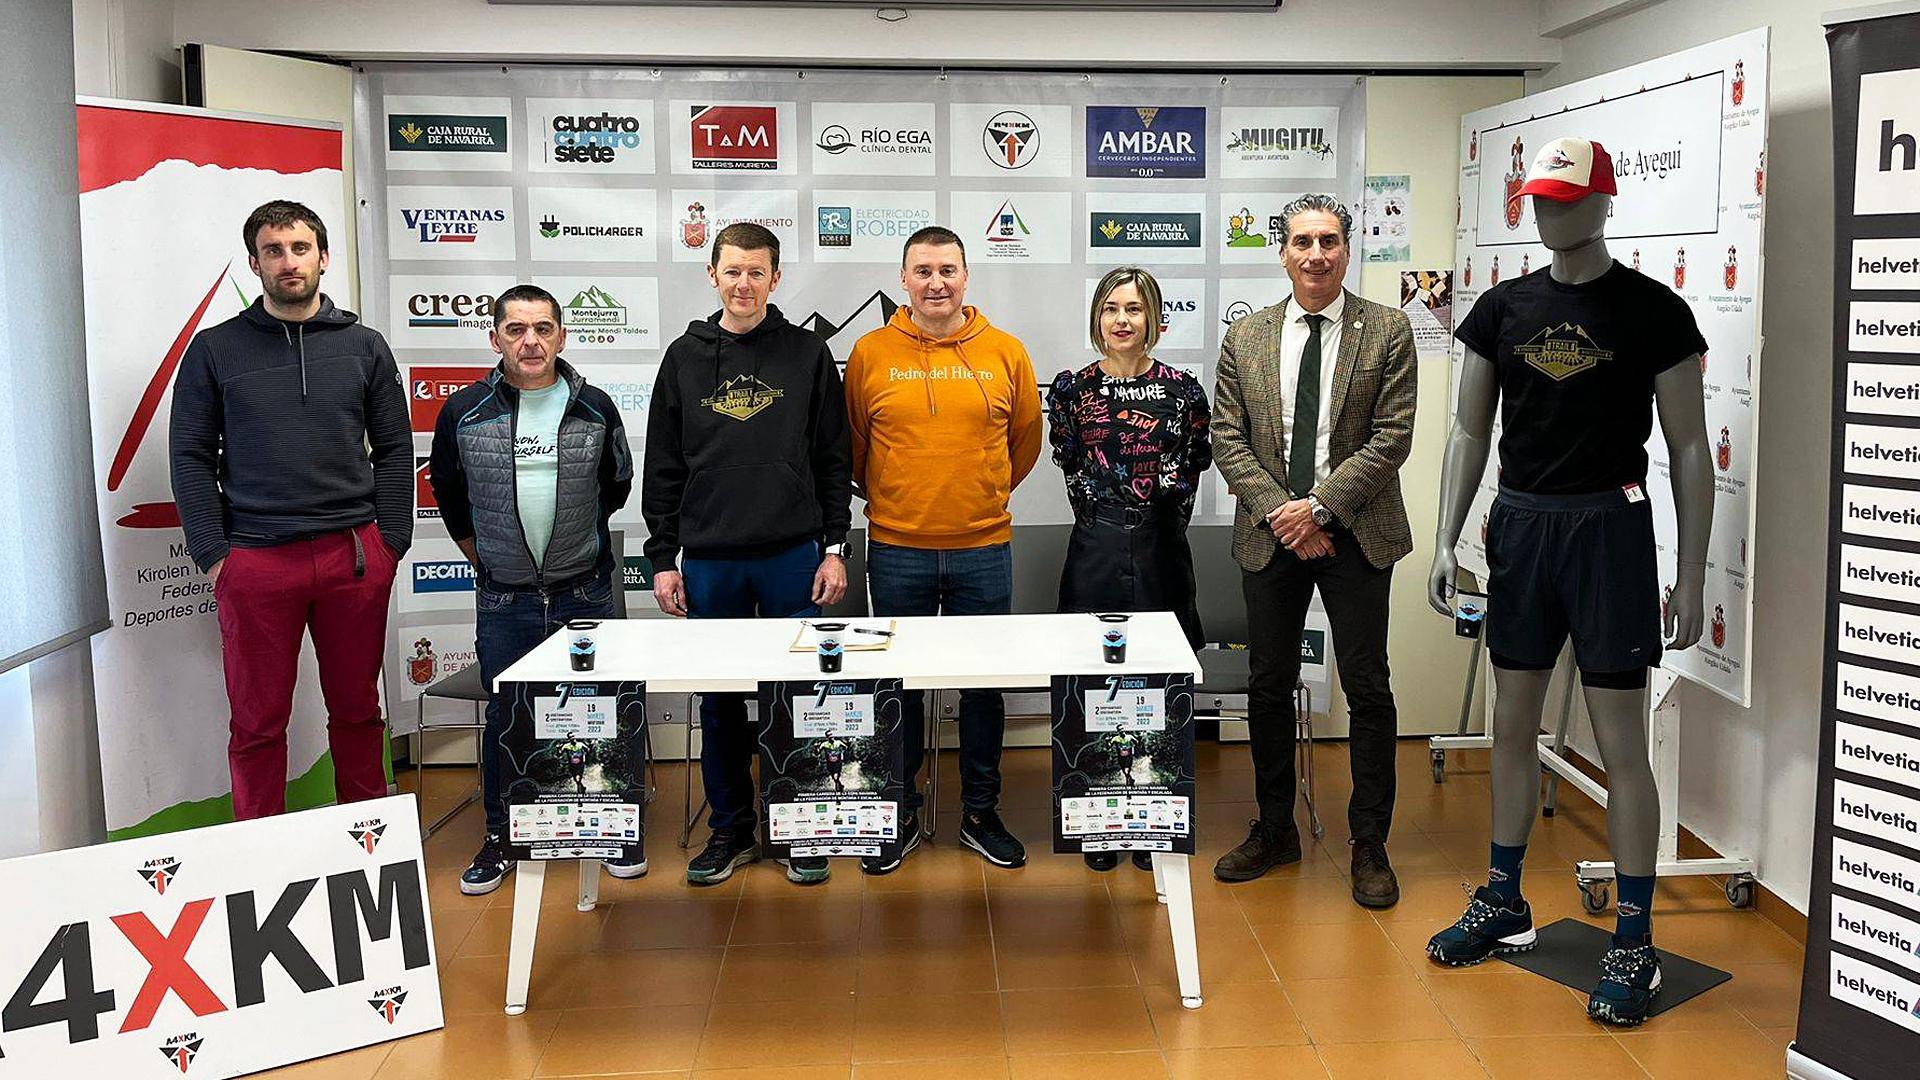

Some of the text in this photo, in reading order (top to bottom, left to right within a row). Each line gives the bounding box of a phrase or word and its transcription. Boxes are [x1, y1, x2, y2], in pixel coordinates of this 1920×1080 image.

[552, 112, 640, 133] cuatro
[427, 127, 490, 137] CAJA RURAL
[427, 136, 495, 146] DE NAVARRA
[553, 129, 640, 149] cuatro
[861, 127, 932, 144] RÍO EGA
[1241, 127, 1324, 151] MUGITU
[554, 139, 616, 163] siete
[861, 144, 932, 154] CLÍNICA DENTAL
[1099, 131, 1195, 154] AMBAR
[693, 161, 734, 169] TALLERES
[1616, 141, 1682, 181] de Ayegui
[401, 209, 505, 229] VENTANAS
[857, 208, 930, 219] ELECTRICIDAD
[420, 222, 478, 243] LEYRE
[562, 226, 643, 238] POLICHARGER
[1126, 222, 1185, 232] CAJA RURAL
[1126, 232, 1190, 241] DE NAVARRA
[1858, 257, 1920, 274] helvet
[572, 310, 618, 318] Montejurra
[889, 366, 994, 382] Pedro del Hiero
[1114, 384, 1166, 402] NATURE
[1850, 441, 1920, 463] helveti
[137, 565, 190, 583] Kirolen
[124, 604, 193, 627] Deportes
[443, 662, 456, 672] DE
[556, 682, 574, 710] 7
[814, 680, 832, 709] 7
[1105, 676, 1124, 704] 7
[588, 704, 596, 712] 19
[846, 702, 854, 710] 19
[1136, 696, 1144, 704] 19
[1842, 739, 1920, 773] helvetia
[353, 817, 382, 830] A4XKM
[1840, 797, 1918, 834] helvetia
[143, 856, 176, 870] A4XKM
[1839, 855, 1915, 893] helvetia
[1838, 912, 1912, 952] helvetia
[0, 859, 430, 1058] 4XKM
[373, 985, 402, 999] A4XKM
[1836, 970, 1909, 1012] helvetia
[166, 1032, 198, 1046] A4XKM
